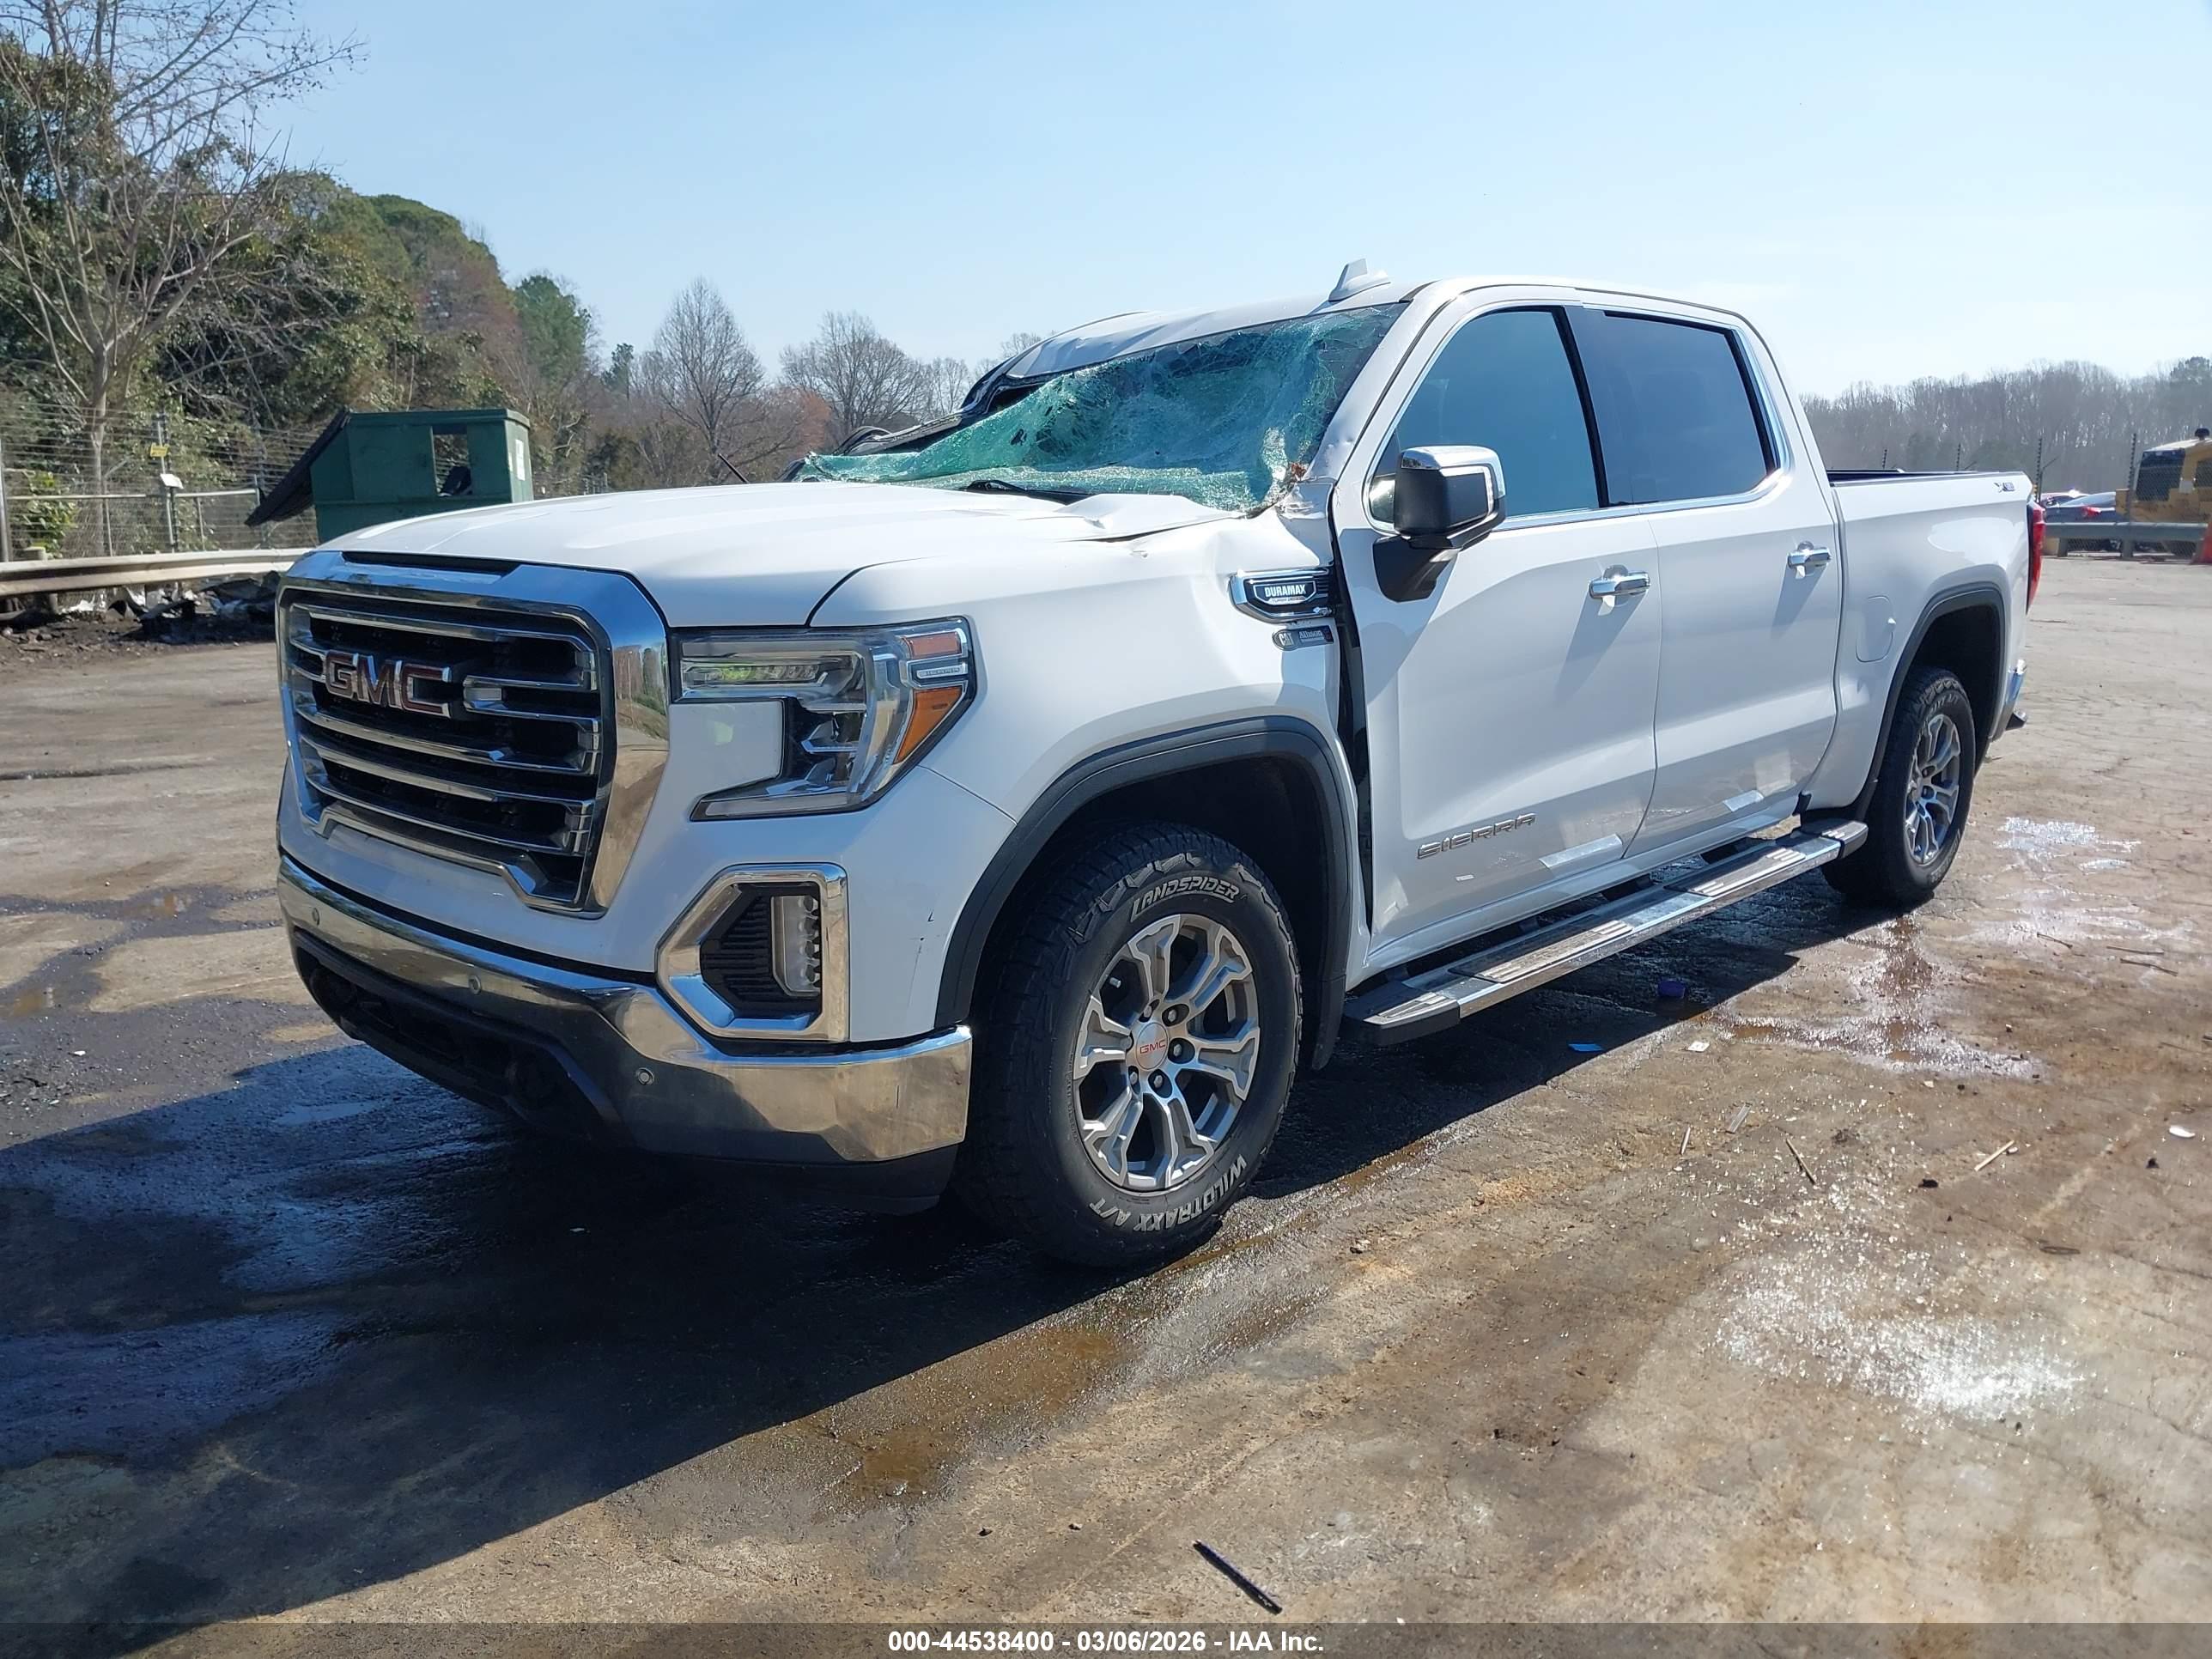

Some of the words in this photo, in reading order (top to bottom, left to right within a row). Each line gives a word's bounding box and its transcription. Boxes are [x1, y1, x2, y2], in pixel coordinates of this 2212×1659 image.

[1264, 584, 1306, 598] DURAMAX
[325, 649, 452, 720] GMC
[1417, 812, 1537, 860] SIERRA
[1129, 876, 1240, 923] LANDSPIDER
[1139, 1039, 1166, 1054] GMC
[1089, 1197, 1132, 1227] A/T
[1133, 1153, 1248, 1232] WILDTRAXX
